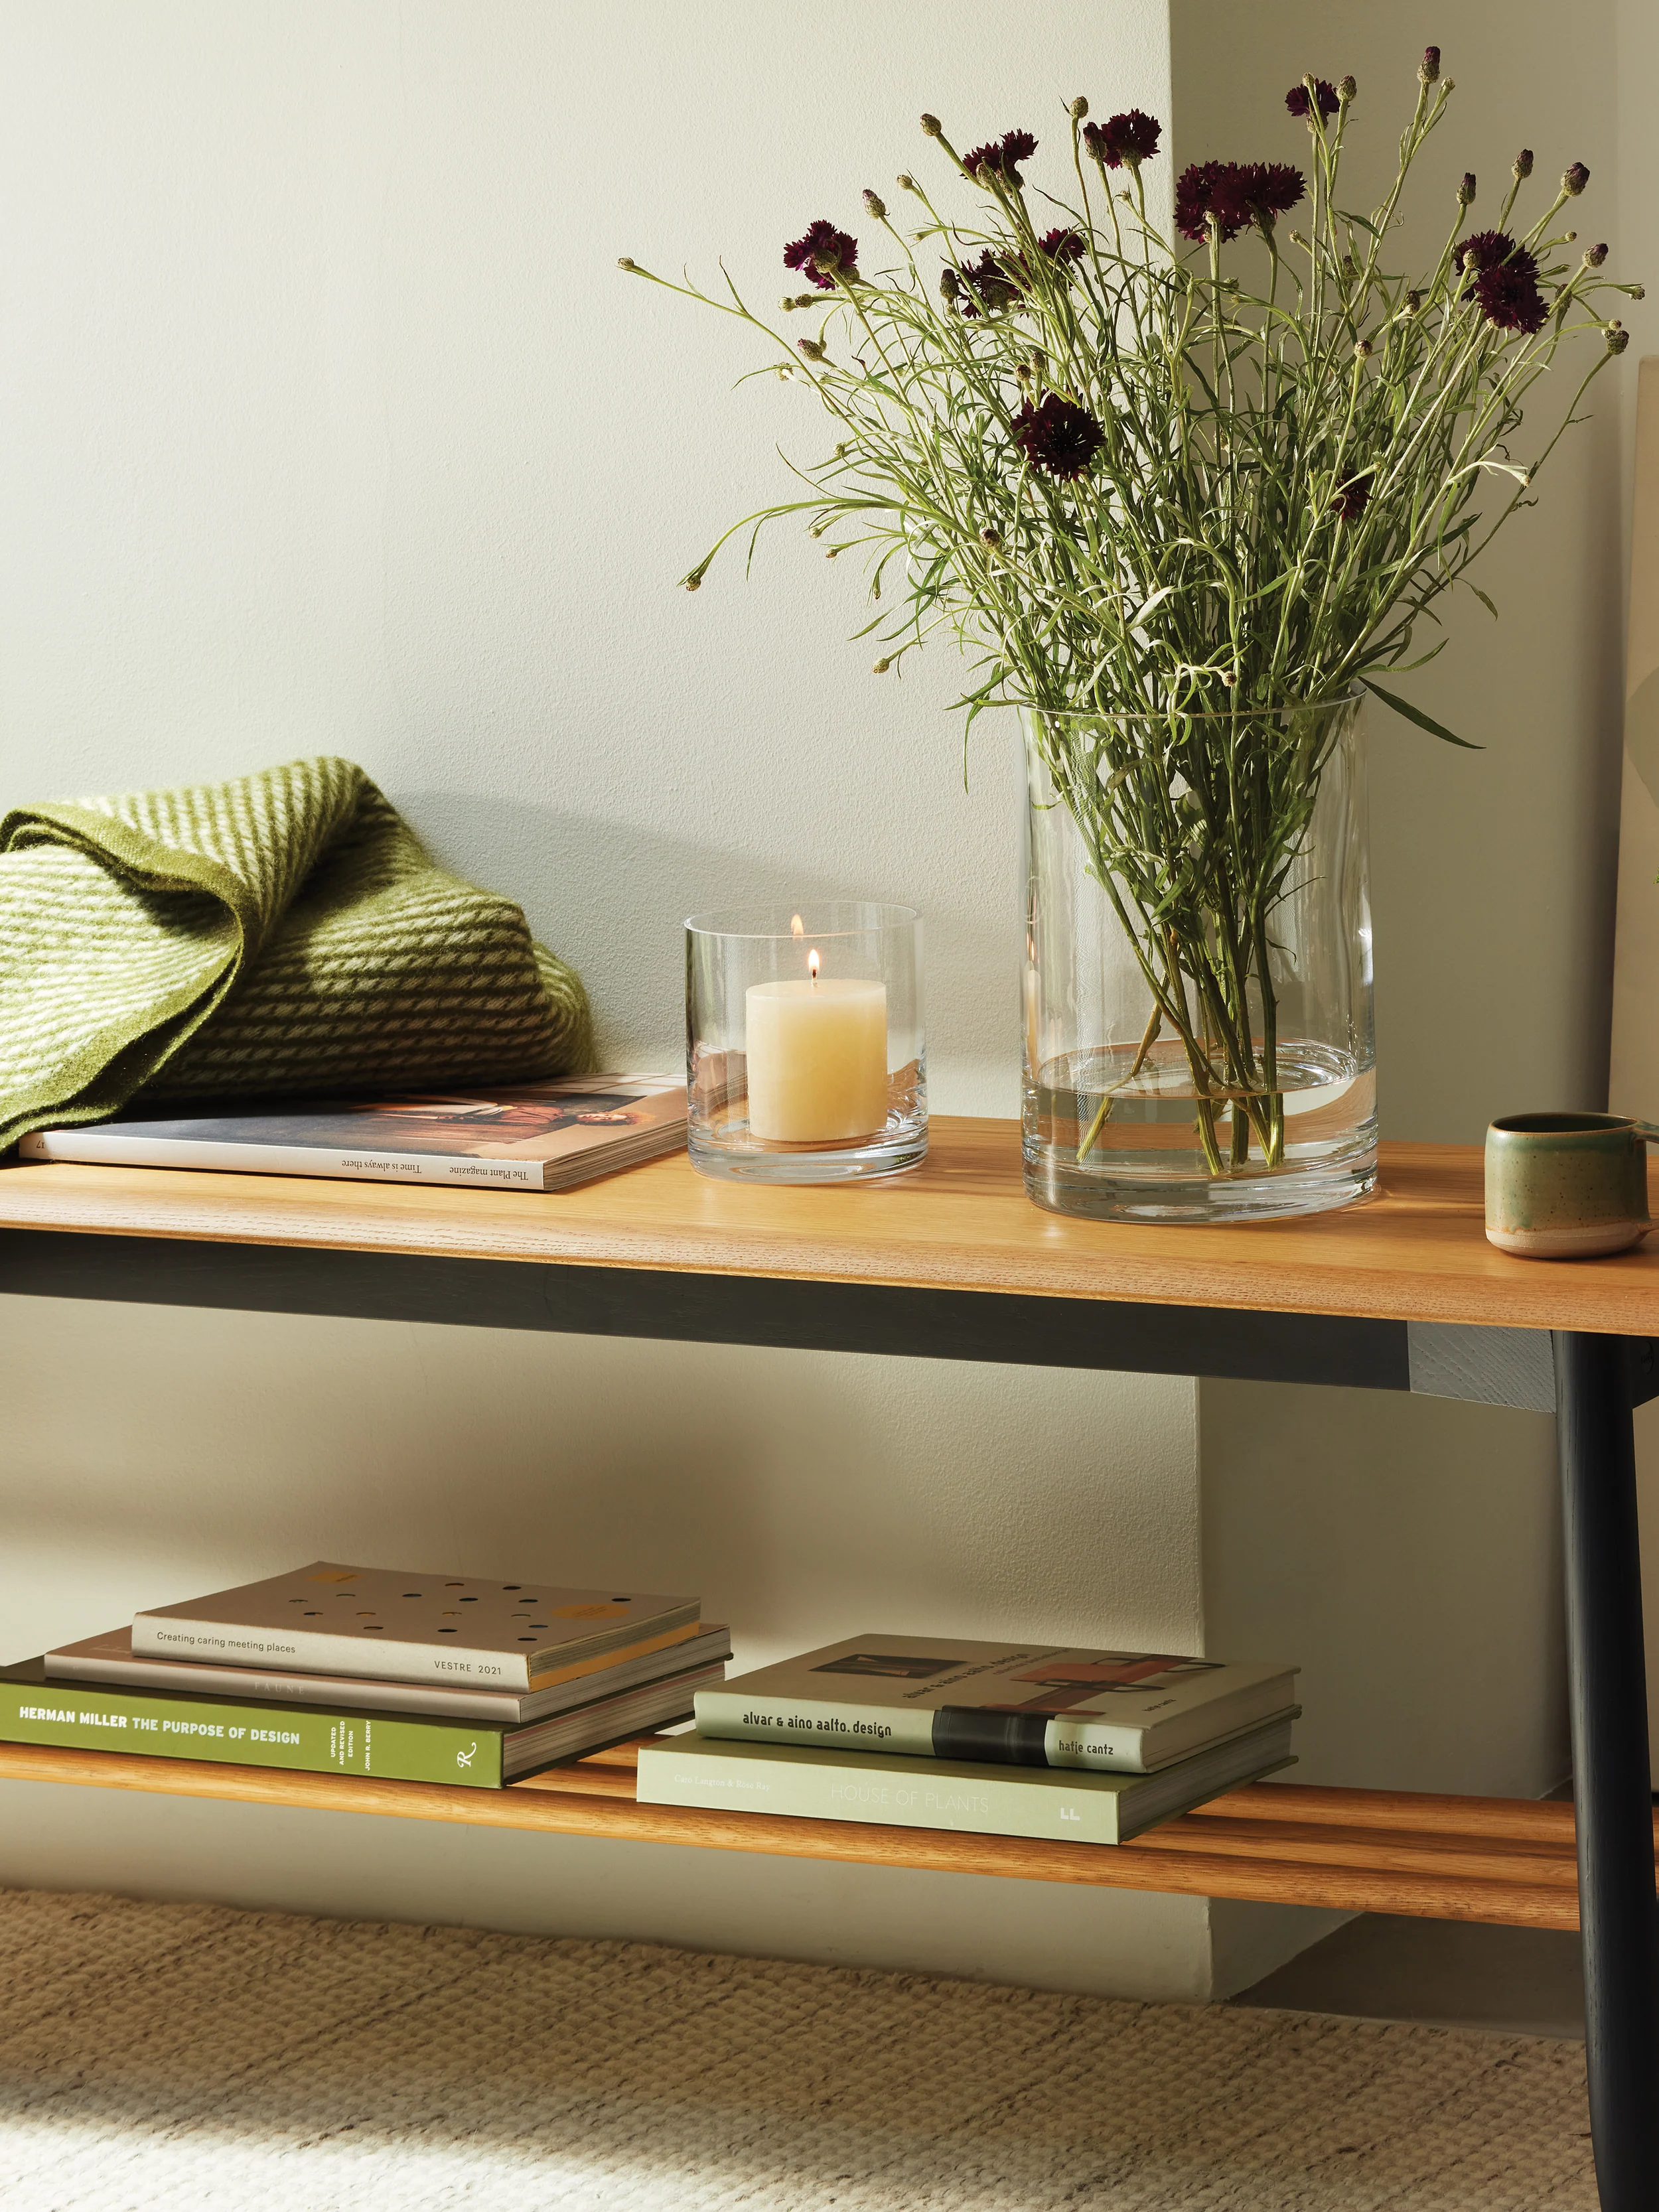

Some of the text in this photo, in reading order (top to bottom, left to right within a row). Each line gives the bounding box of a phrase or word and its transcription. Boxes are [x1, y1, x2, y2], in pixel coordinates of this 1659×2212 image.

[342, 1159, 422, 1174] Time is always there
[449, 1166, 529, 1180] The Plant magazine
[157, 1631, 295, 1653] Creating caring meeting places
[434, 1660, 502, 1675] VESTRE 2021
[254, 1681, 305, 1694] FAUNE
[19, 1706, 300, 1745] HERMAN MILLER THE PURPOSE OF DESIGN
[743, 1712, 892, 1738] alvar & aino aalto. design
[1058, 1740, 1114, 1755] hatje cantz
[674, 1774, 693, 1783] Caro
[694, 1776, 725, 1787] Langton
[736, 1780, 755, 1789] Rose
[756, 1781, 770, 1792] Ray
[831, 1784, 989, 1813] HOUSE OF PLANTS
